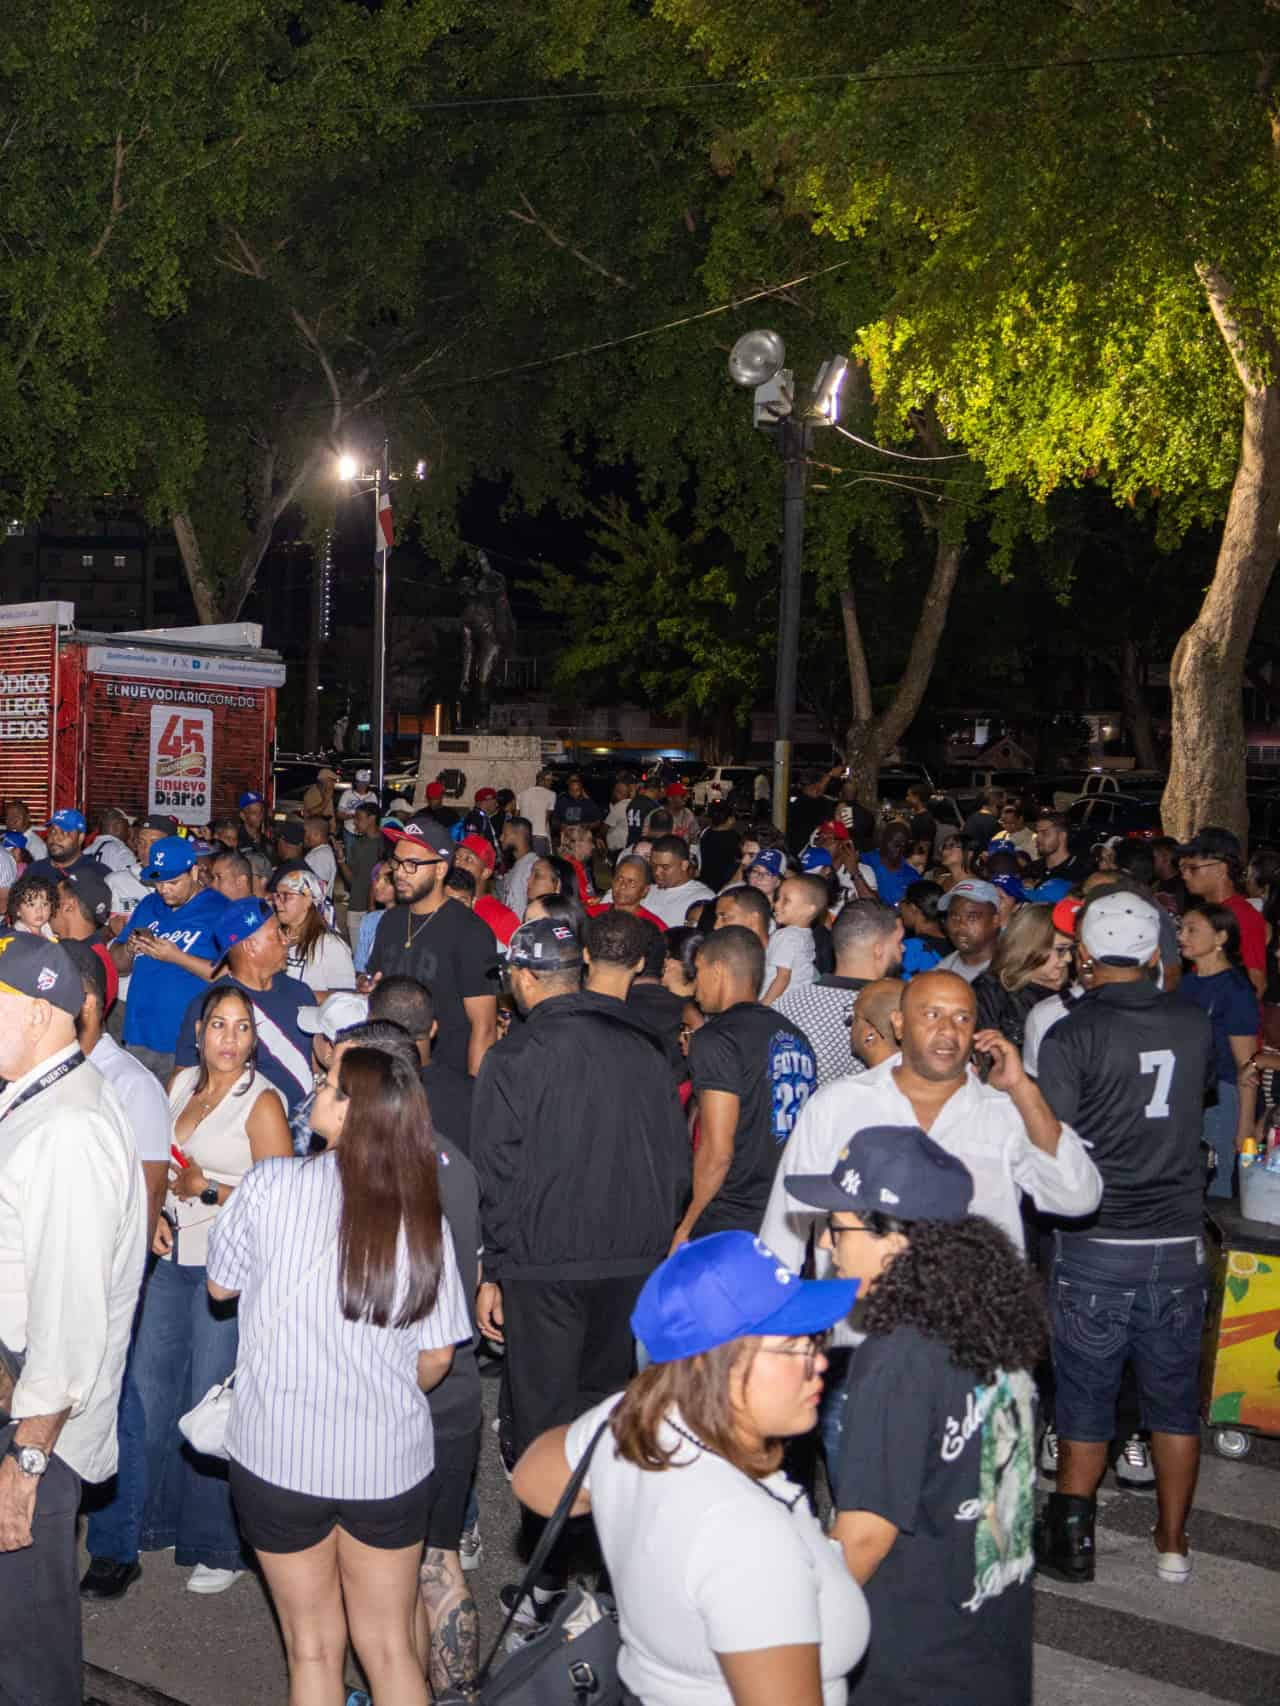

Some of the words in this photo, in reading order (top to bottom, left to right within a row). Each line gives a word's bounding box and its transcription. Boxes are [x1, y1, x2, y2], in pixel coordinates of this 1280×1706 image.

[0, 719, 49, 740] LEJOS
[158, 714, 204, 758] 45
[39, 1063, 70, 1087] PUERTO
[1138, 1049, 1176, 1119] 7
